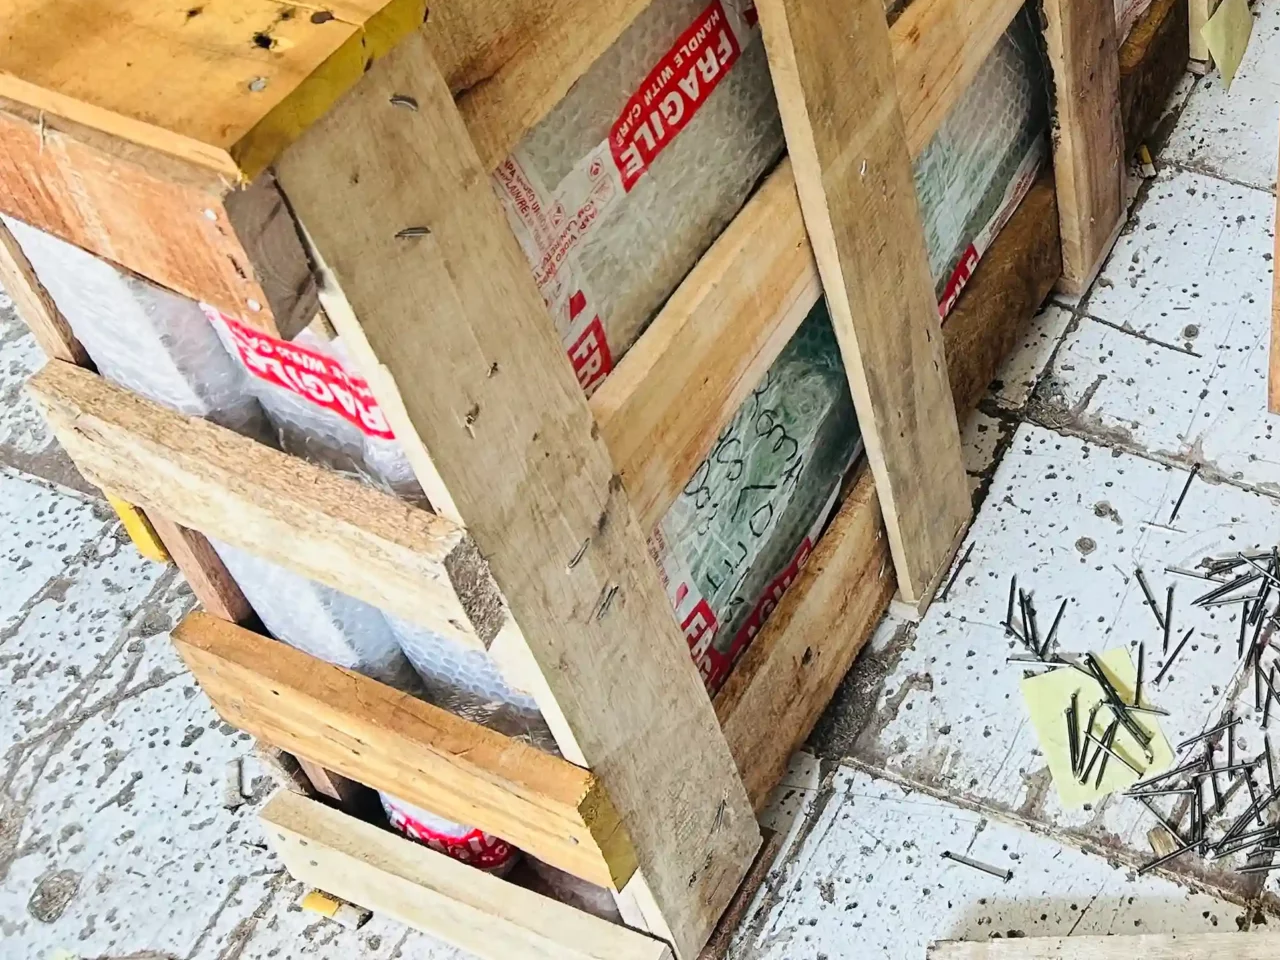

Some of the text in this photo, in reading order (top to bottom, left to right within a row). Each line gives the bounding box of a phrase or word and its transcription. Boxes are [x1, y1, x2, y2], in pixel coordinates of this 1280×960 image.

[616, 9, 720, 147] HANDLE WITH CARE
[620, 29, 734, 179] FRAGILE
